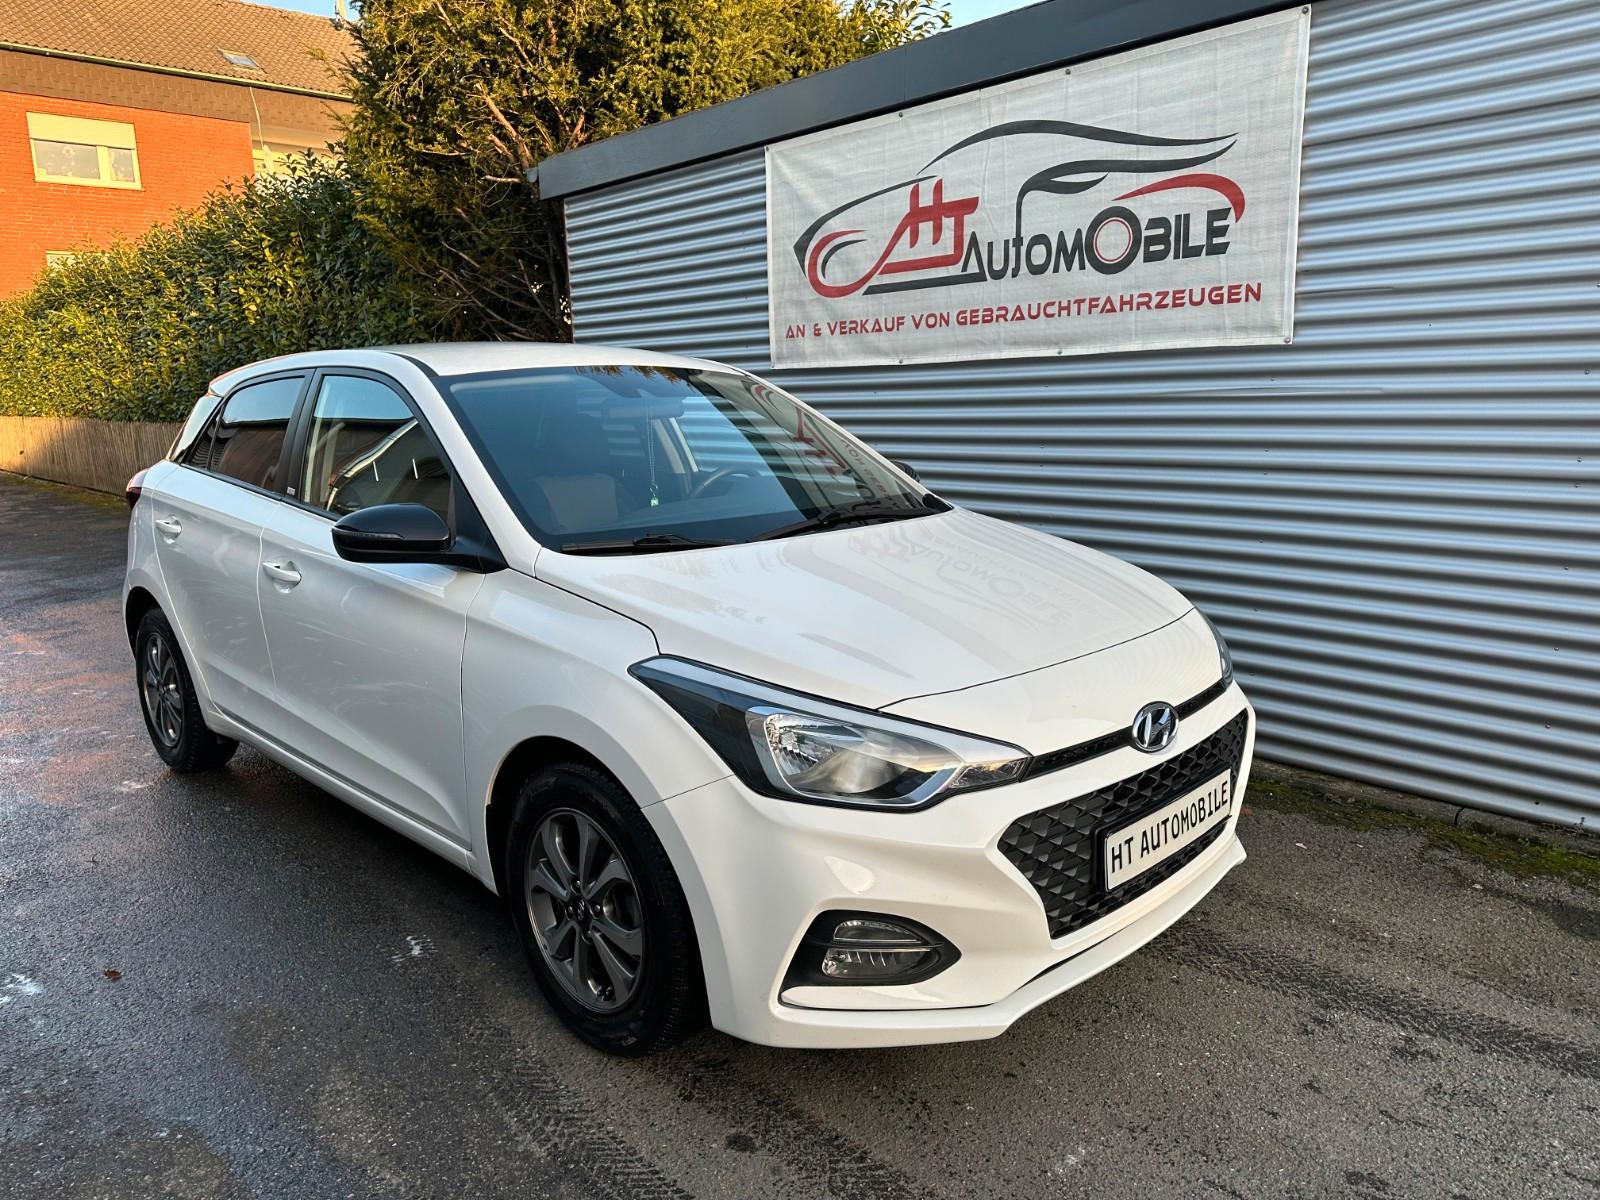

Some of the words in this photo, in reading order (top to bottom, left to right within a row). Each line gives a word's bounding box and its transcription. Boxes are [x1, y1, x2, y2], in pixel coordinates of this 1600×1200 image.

[960, 205, 1233, 282] AUTOMOBILE
[785, 323, 806, 339] AN
[812, 322, 822, 337] &
[827, 315, 906, 336] VERKAUF
[910, 311, 951, 329] VON
[955, 282, 1263, 326] GEBRAUCHTFAHRZEUGEN
[1111, 836, 1134, 874] HT
[1140, 780, 1229, 858] AUTOMOBILE
